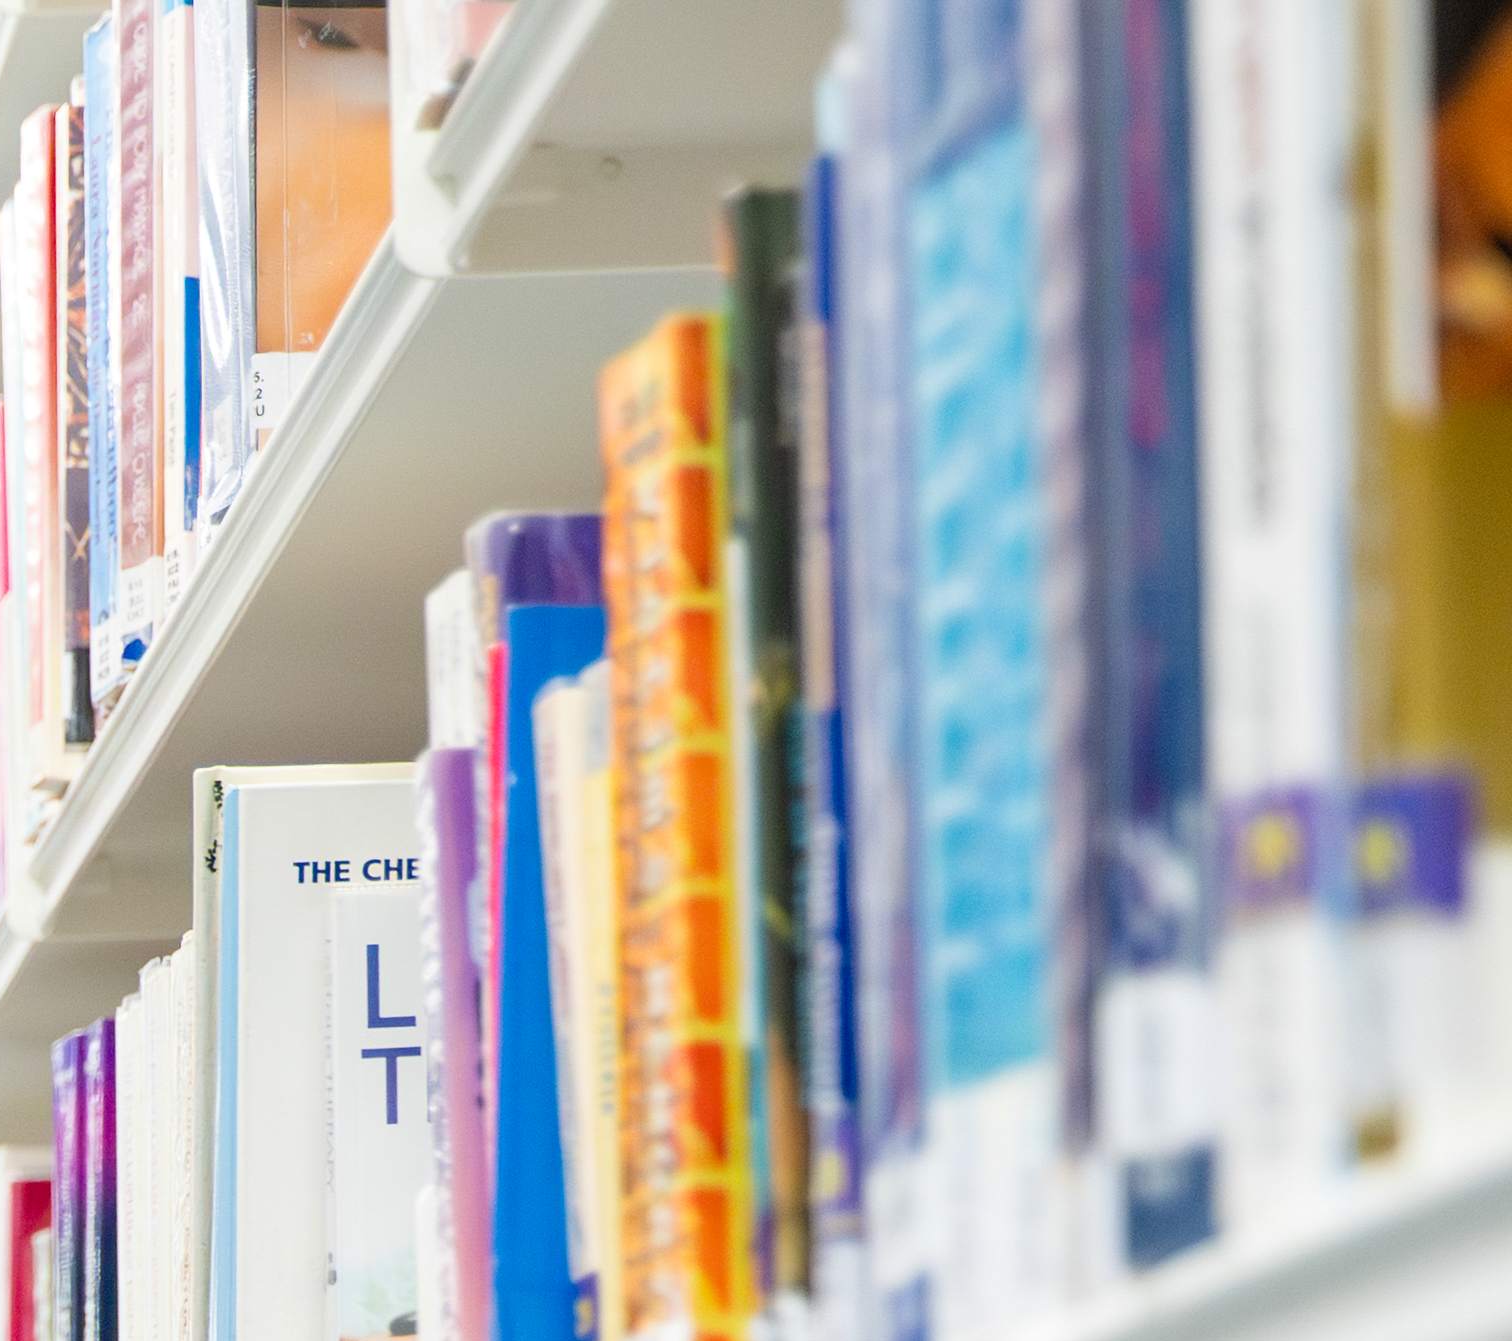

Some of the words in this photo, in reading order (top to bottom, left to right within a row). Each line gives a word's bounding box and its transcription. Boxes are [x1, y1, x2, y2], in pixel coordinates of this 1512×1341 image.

[293, 859, 352, 883] THE
[366, 943, 418, 1029] L
[360, 1045, 422, 1125] T
